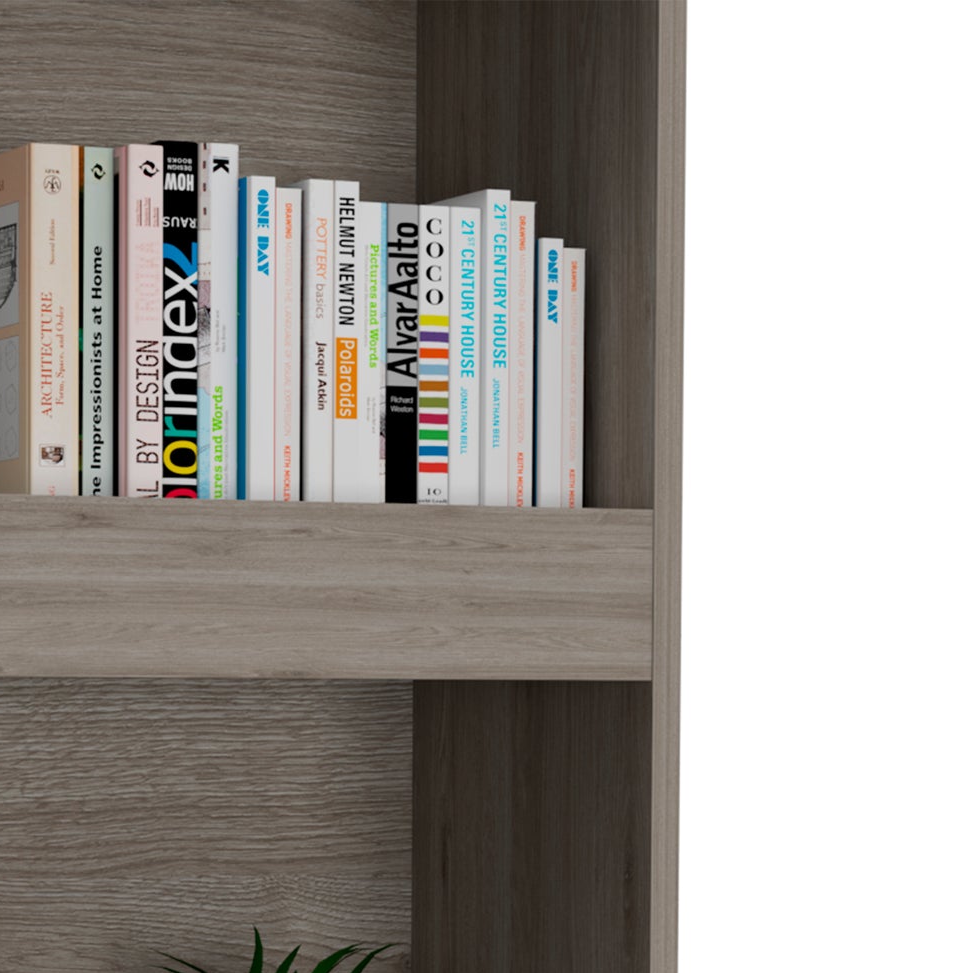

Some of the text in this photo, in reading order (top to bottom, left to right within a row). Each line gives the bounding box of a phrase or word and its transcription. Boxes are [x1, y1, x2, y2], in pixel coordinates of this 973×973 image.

[164, 173, 195, 192] HOW
[257, 188, 269, 276] ONE DAY
[285, 202, 293, 240] DRAWING
[518, 215, 526, 251] DRAWING
[91, 245, 103, 300] Home
[315, 217, 328, 319] POTTERY basics
[338, 197, 355, 326] HELMUT NEWTON
[461, 248, 475, 321] CENTURY
[493, 233, 507, 309] CENTURY
[547, 249, 559, 324] ONE DAY
[571, 260, 579, 292] DRAWING
[56, 305, 65, 332] Order
[91, 305, 102, 326] at
[370, 243, 380, 369] Pictures and Words
[41, 291, 53, 418] ARCHITECTURE
[56, 334, 64, 349] and
[461, 325, 474, 378] HOUSE
[492, 313, 507, 369] HOUSE
[90, 328, 104, 469] Impressionists
[136, 339, 160, 422] DESIGN
[315, 341, 328, 411] Jacqui Atkin
[339, 339, 355, 417] Polaroids
[212, 385, 224, 432] Words
[459, 386, 468, 455] JONATHAN BELL
[492, 378, 500, 448] JONATHAN BELL
[136, 437, 160, 464] BY
[212, 435, 224, 462] and
[283, 445, 291, 468] KEITH
[516, 452, 524, 474] KEITH
